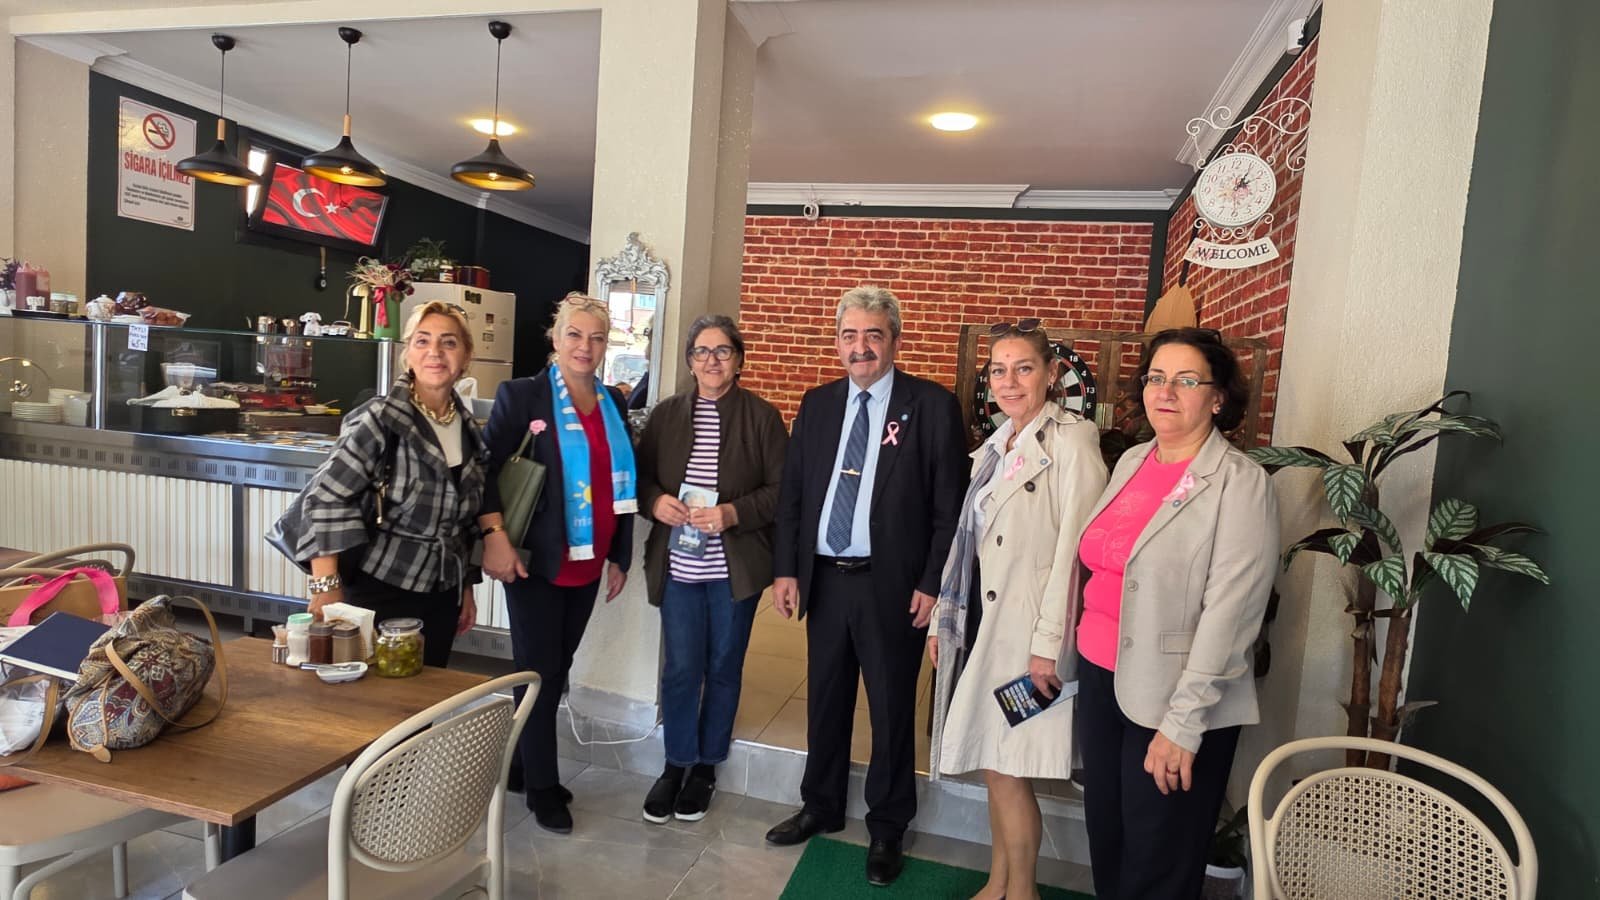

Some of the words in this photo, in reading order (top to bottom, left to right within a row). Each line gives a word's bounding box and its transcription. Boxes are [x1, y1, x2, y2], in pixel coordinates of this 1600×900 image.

[124, 150, 157, 176] SİGARA
[1231, 160, 1242, 169] 12
[1217, 165, 1226, 173] 11
[1208, 174, 1217, 182] 10
[1256, 170, 1264, 179] 2
[1260, 183, 1268, 192] 3
[1255, 197, 1262, 205] 4
[1218, 206, 1225, 217] 7
[1231, 208, 1238, 217] 6
[1245, 206, 1252, 214] 5
[1198, 243, 1270, 259] WELCOME
[1056, 346, 1060, 354] 1
